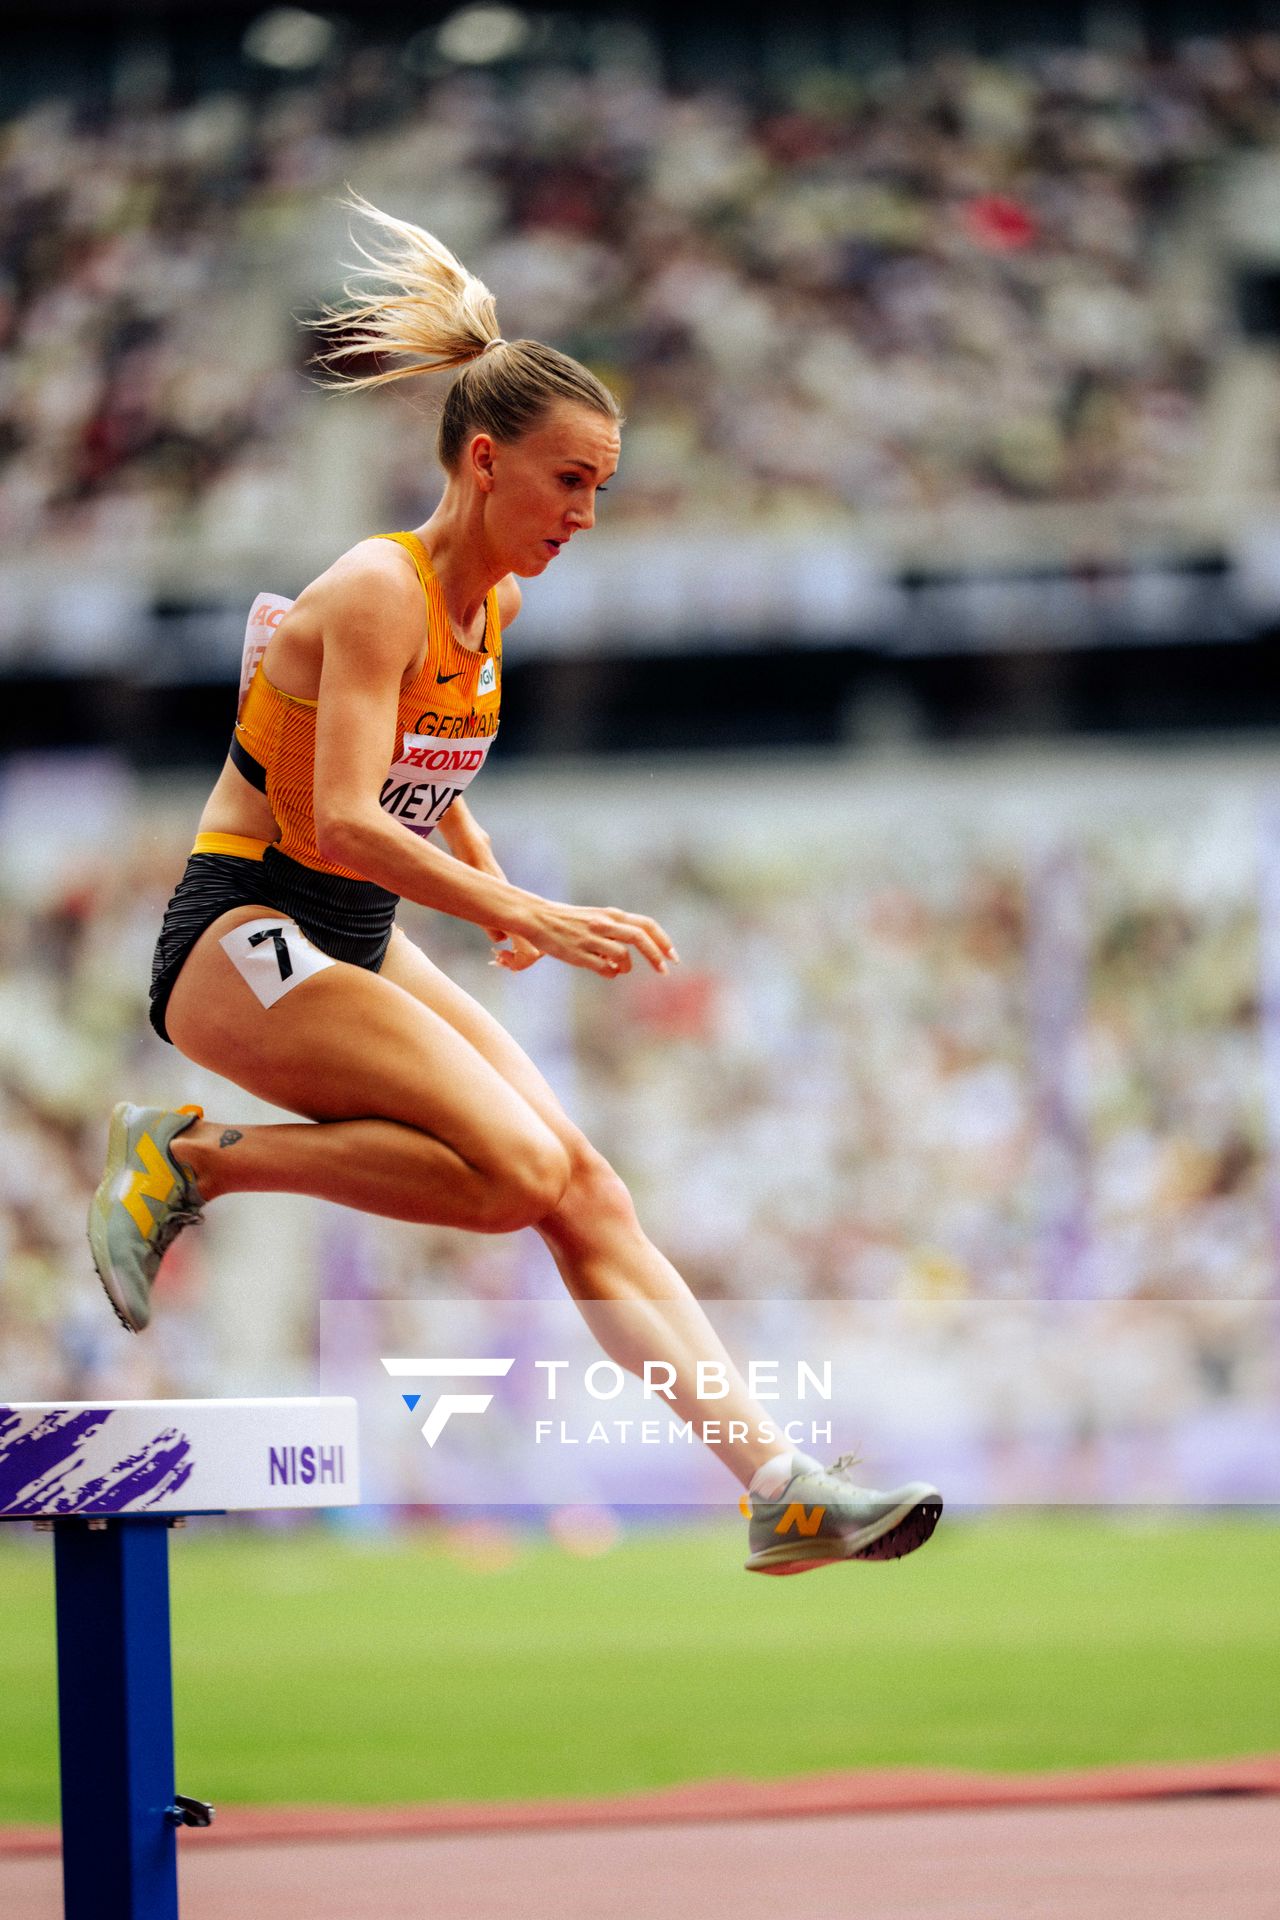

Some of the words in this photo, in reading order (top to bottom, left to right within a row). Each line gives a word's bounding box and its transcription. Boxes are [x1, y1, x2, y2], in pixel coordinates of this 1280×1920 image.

[415, 712, 498, 739] GERMAN
[399, 746, 484, 771] HOND
[248, 928, 293, 982] 7
[269, 1445, 345, 1486] NISHI
